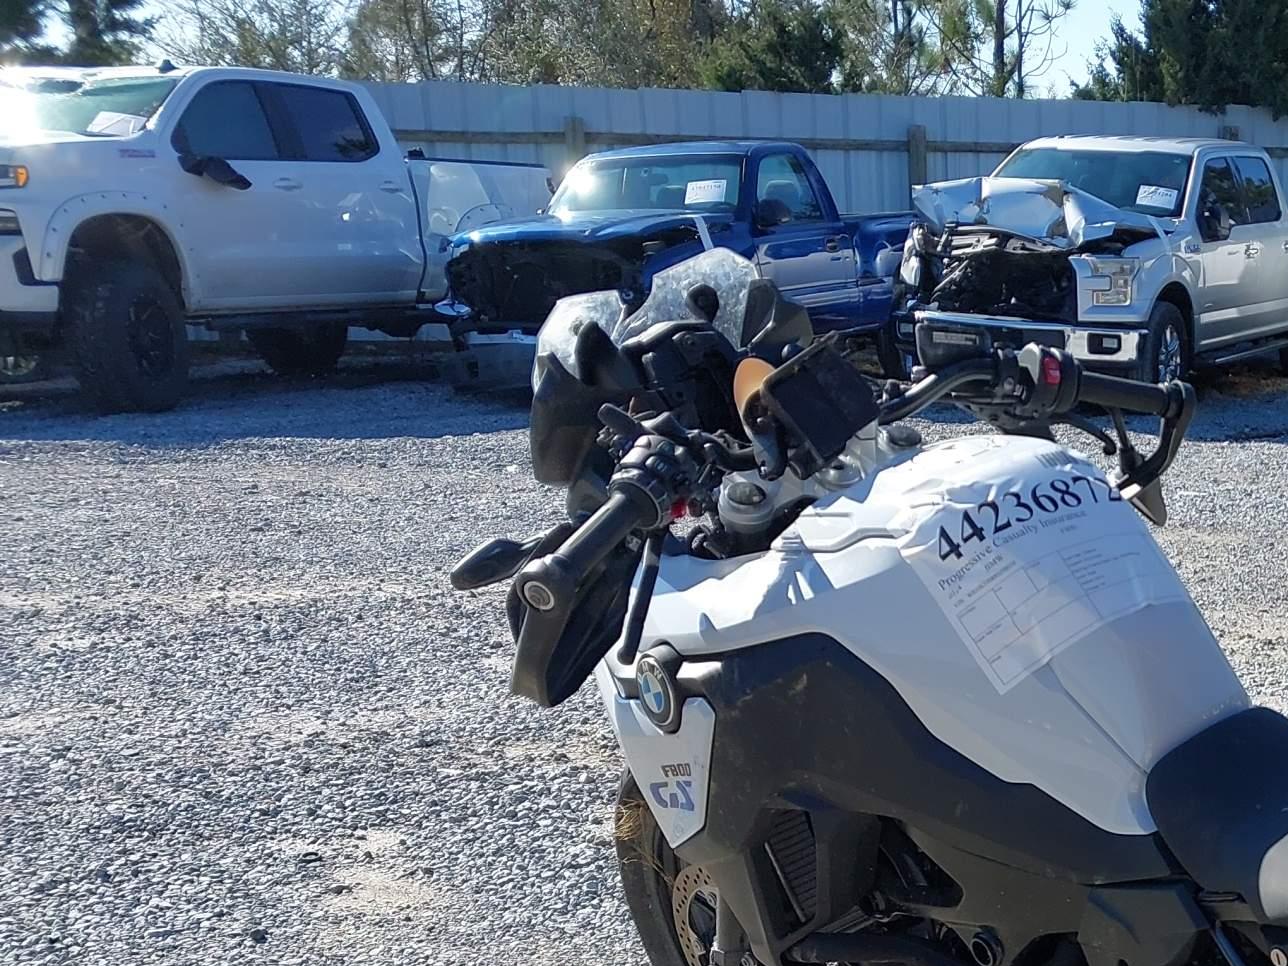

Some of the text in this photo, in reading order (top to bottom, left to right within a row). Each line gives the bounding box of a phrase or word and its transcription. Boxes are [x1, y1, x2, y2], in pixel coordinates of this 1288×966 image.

[937, 475, 1122, 564] 44236872
[937, 545, 994, 592] Progressive
[992, 522, 1039, 550] Casualty
[649, 780, 695, 812] GS
